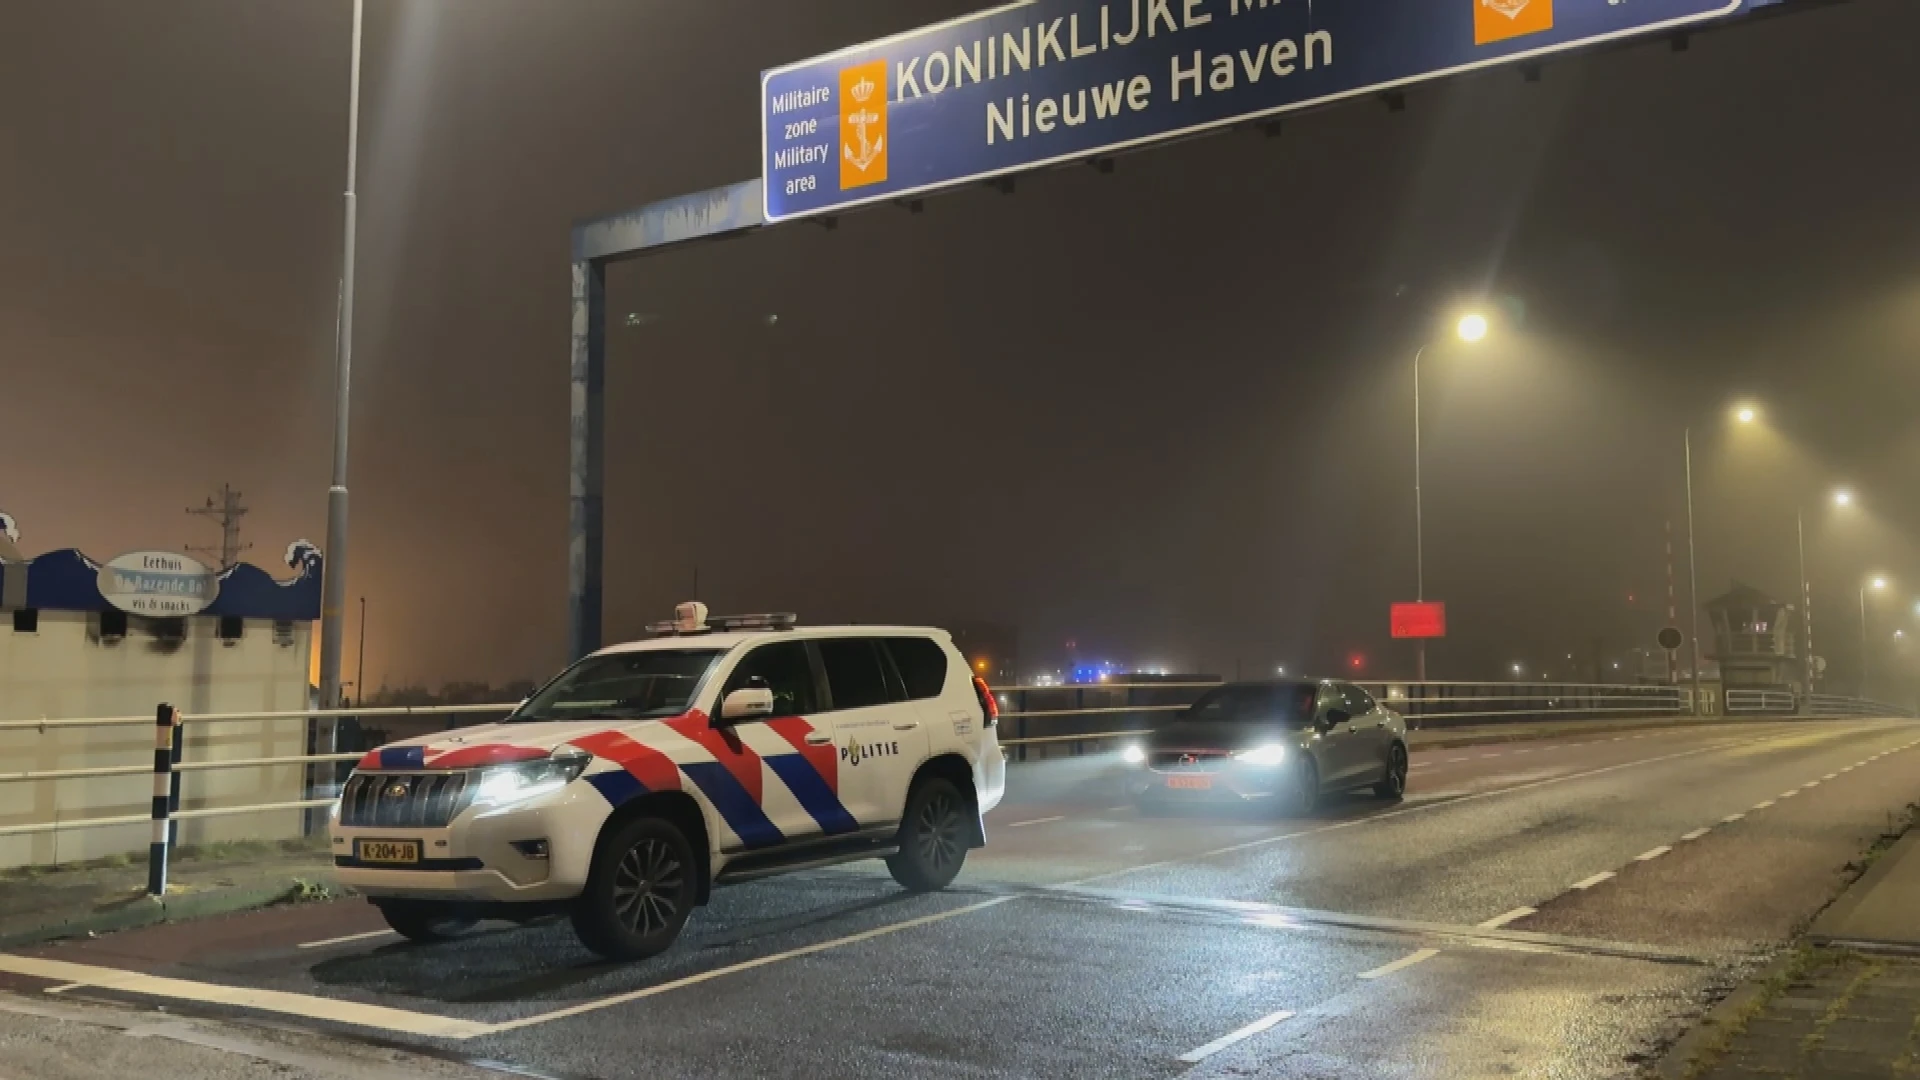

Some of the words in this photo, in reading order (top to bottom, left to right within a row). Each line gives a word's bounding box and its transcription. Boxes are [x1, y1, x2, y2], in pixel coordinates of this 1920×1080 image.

[896, 0, 1212, 103] KONINKLIJKE
[772, 86, 830, 115] Militaire
[986, 74, 1152, 145] Nieuwe
[1171, 29, 1332, 102] Haven
[785, 117, 817, 140] zone
[774, 143, 829, 170] Military
[786, 174, 816, 195] area
[363, 843, 414, 859] K-204-JB
